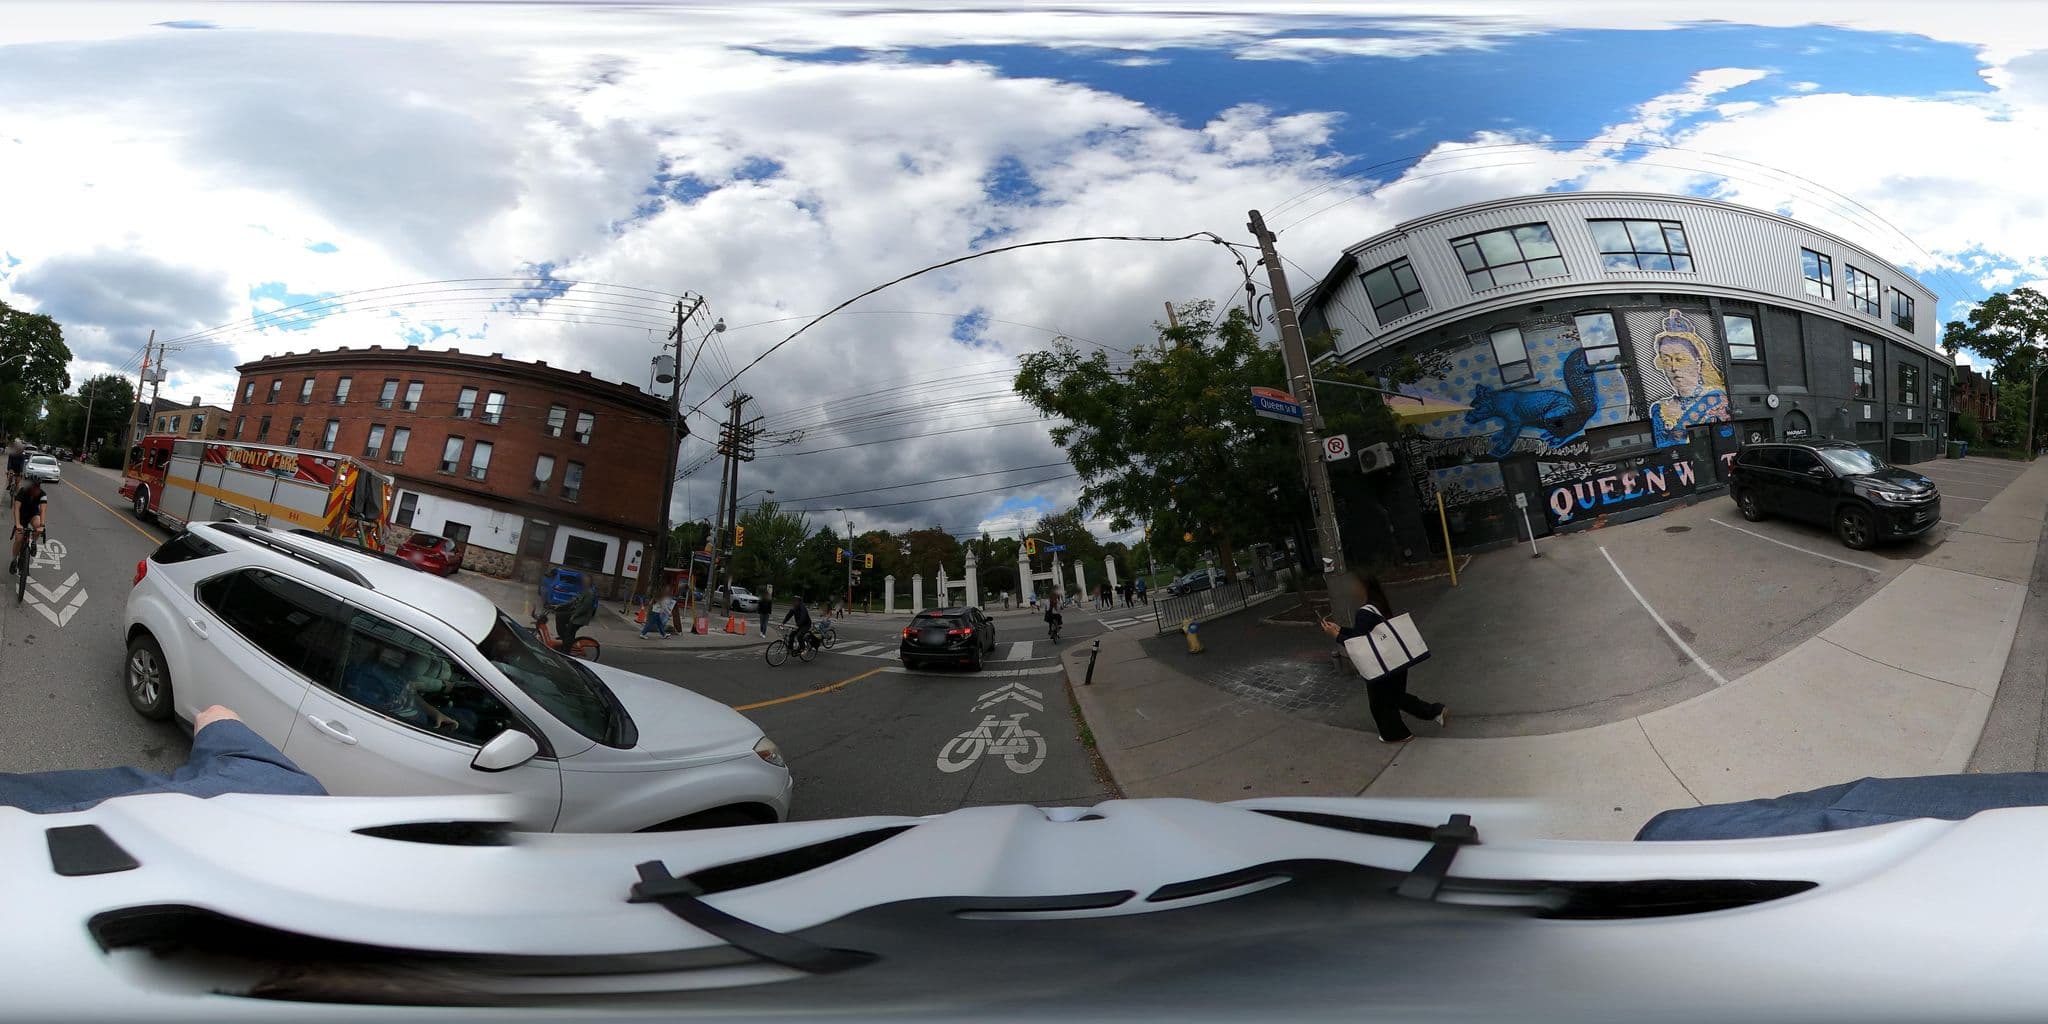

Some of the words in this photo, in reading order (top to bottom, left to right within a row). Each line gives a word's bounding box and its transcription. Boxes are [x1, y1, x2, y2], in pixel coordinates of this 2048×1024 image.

[1260, 397, 1284, 412] Queen
[226, 447, 268, 467] TORONTO
[271, 453, 299, 472] FIRE
[1549, 465, 1667, 524] QUEEN
